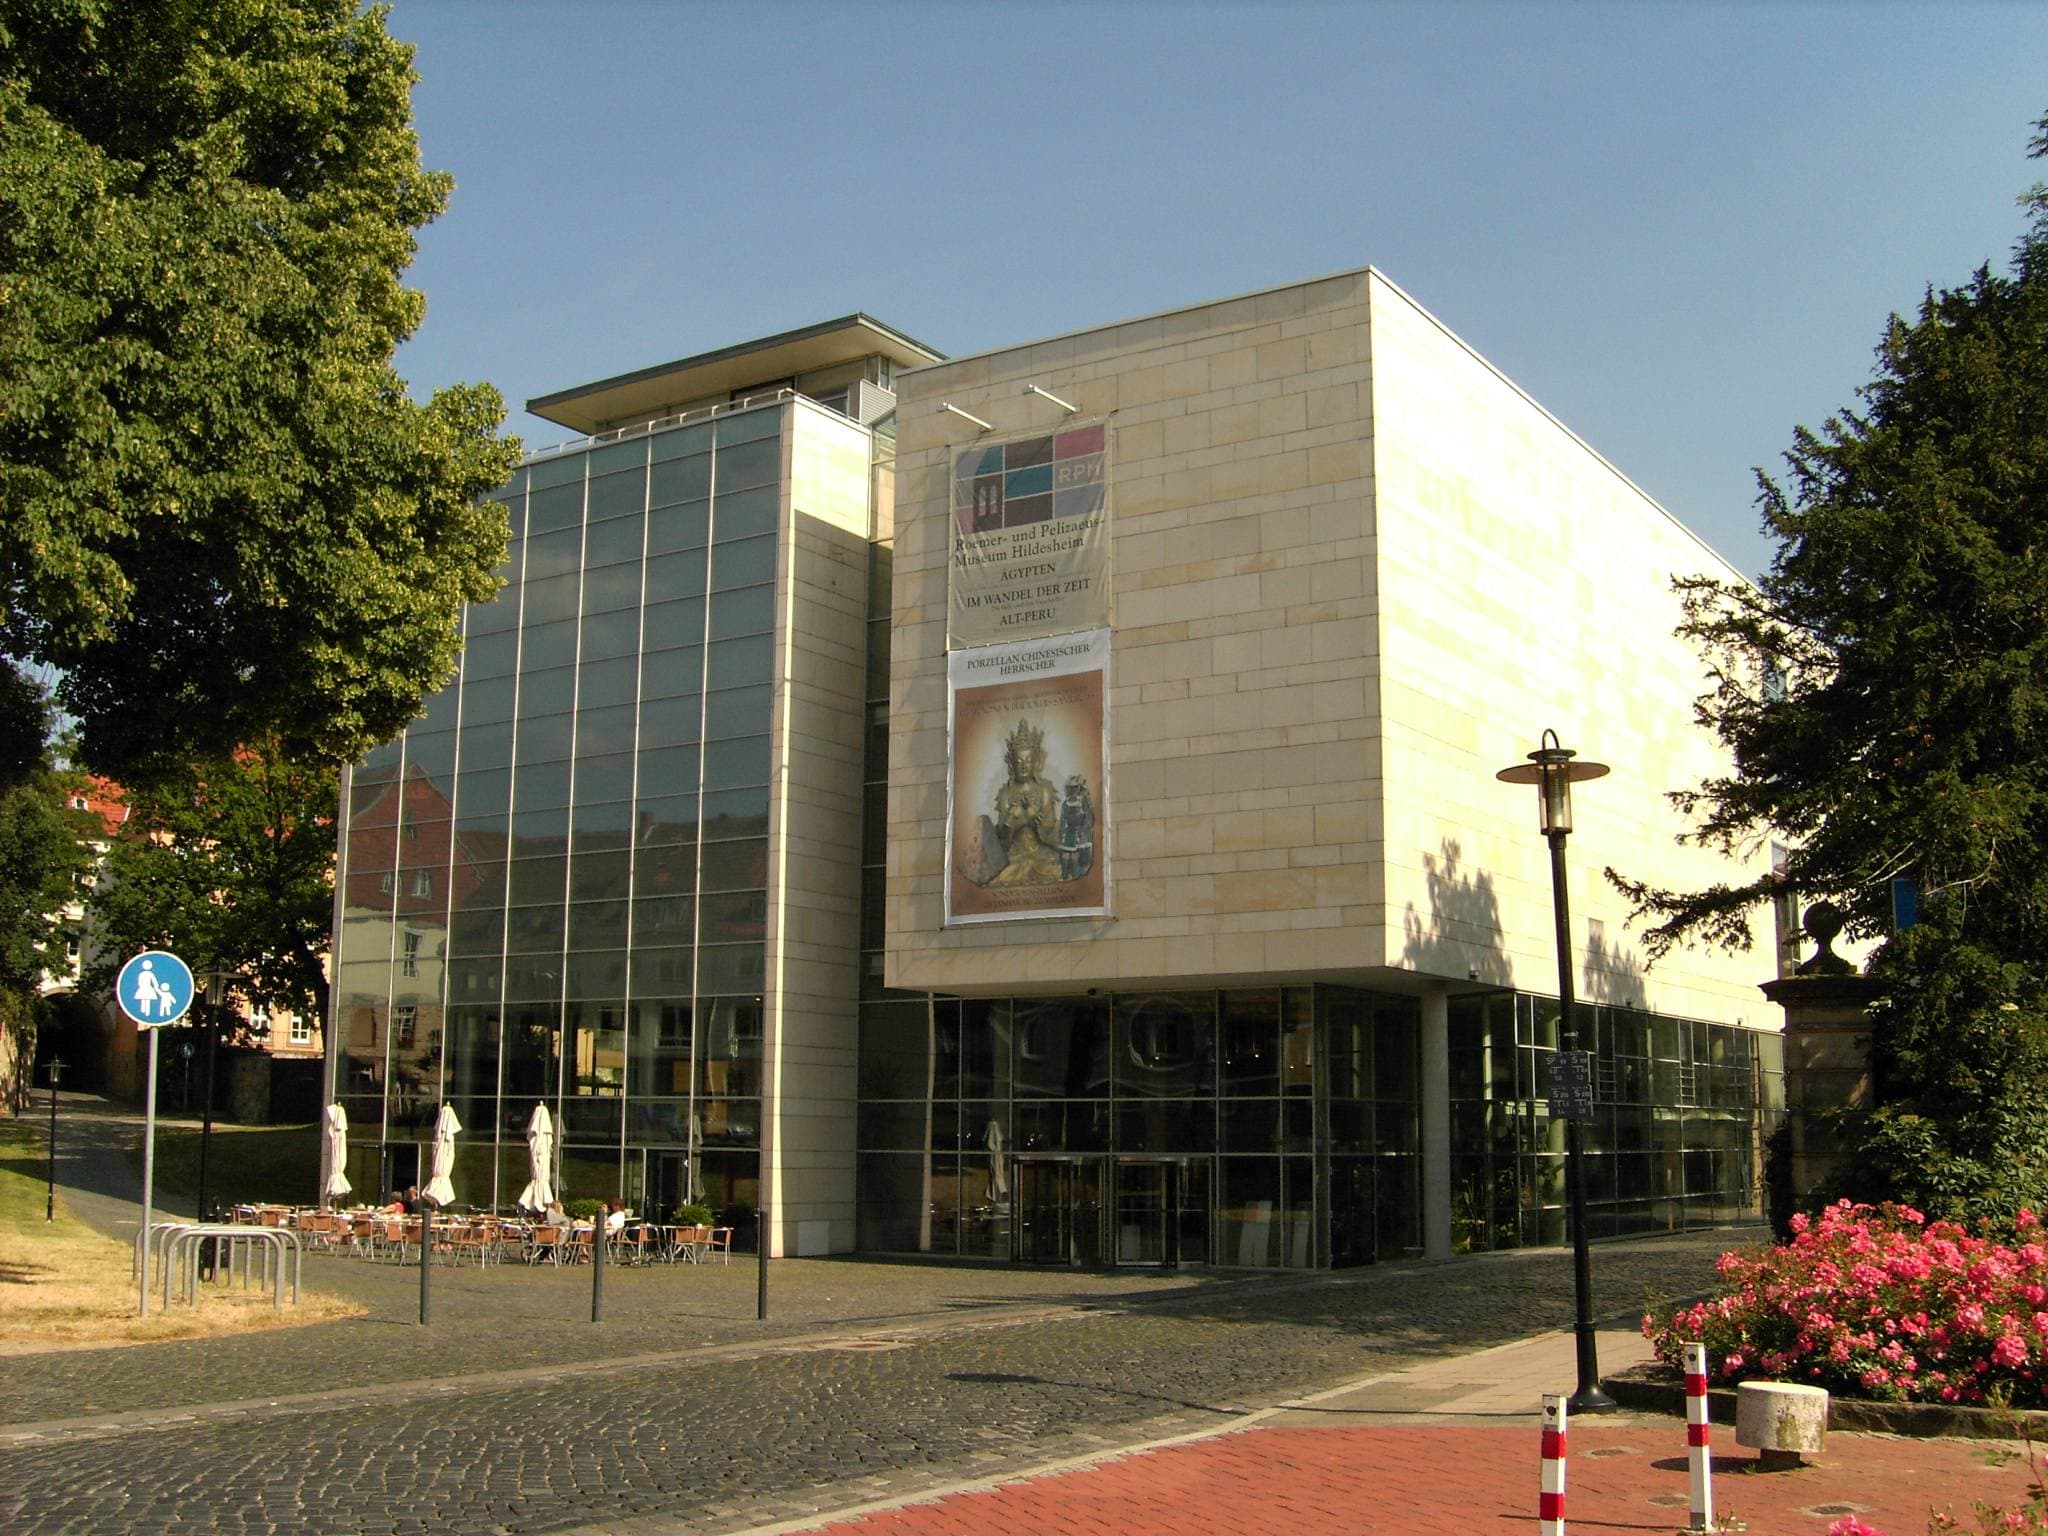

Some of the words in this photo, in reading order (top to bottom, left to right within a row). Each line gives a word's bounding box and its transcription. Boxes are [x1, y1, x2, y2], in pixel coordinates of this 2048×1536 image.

[1059, 463, 1100, 484] RPM
[955, 535, 1008, 552] Roemer-
[1012, 529, 1036, 543] und
[1041, 518, 1105, 538] Pelizaeus-
[955, 552, 1007, 568] Museum
[1012, 536, 1084, 559] Hildesheim
[967, 596, 981, 608] IM
[984, 588, 1033, 605] WANDEL
[1037, 584, 1061, 598] DER
[1064, 578, 1091, 593] ZEIT
[1000, 608, 1056, 626] ALT-PERU
[967, 653, 1020, 669] PORZELLAN
[1022, 643, 1091, 662] CHINESISCHER
[1000, 660, 1056, 675] HERRSCHER
